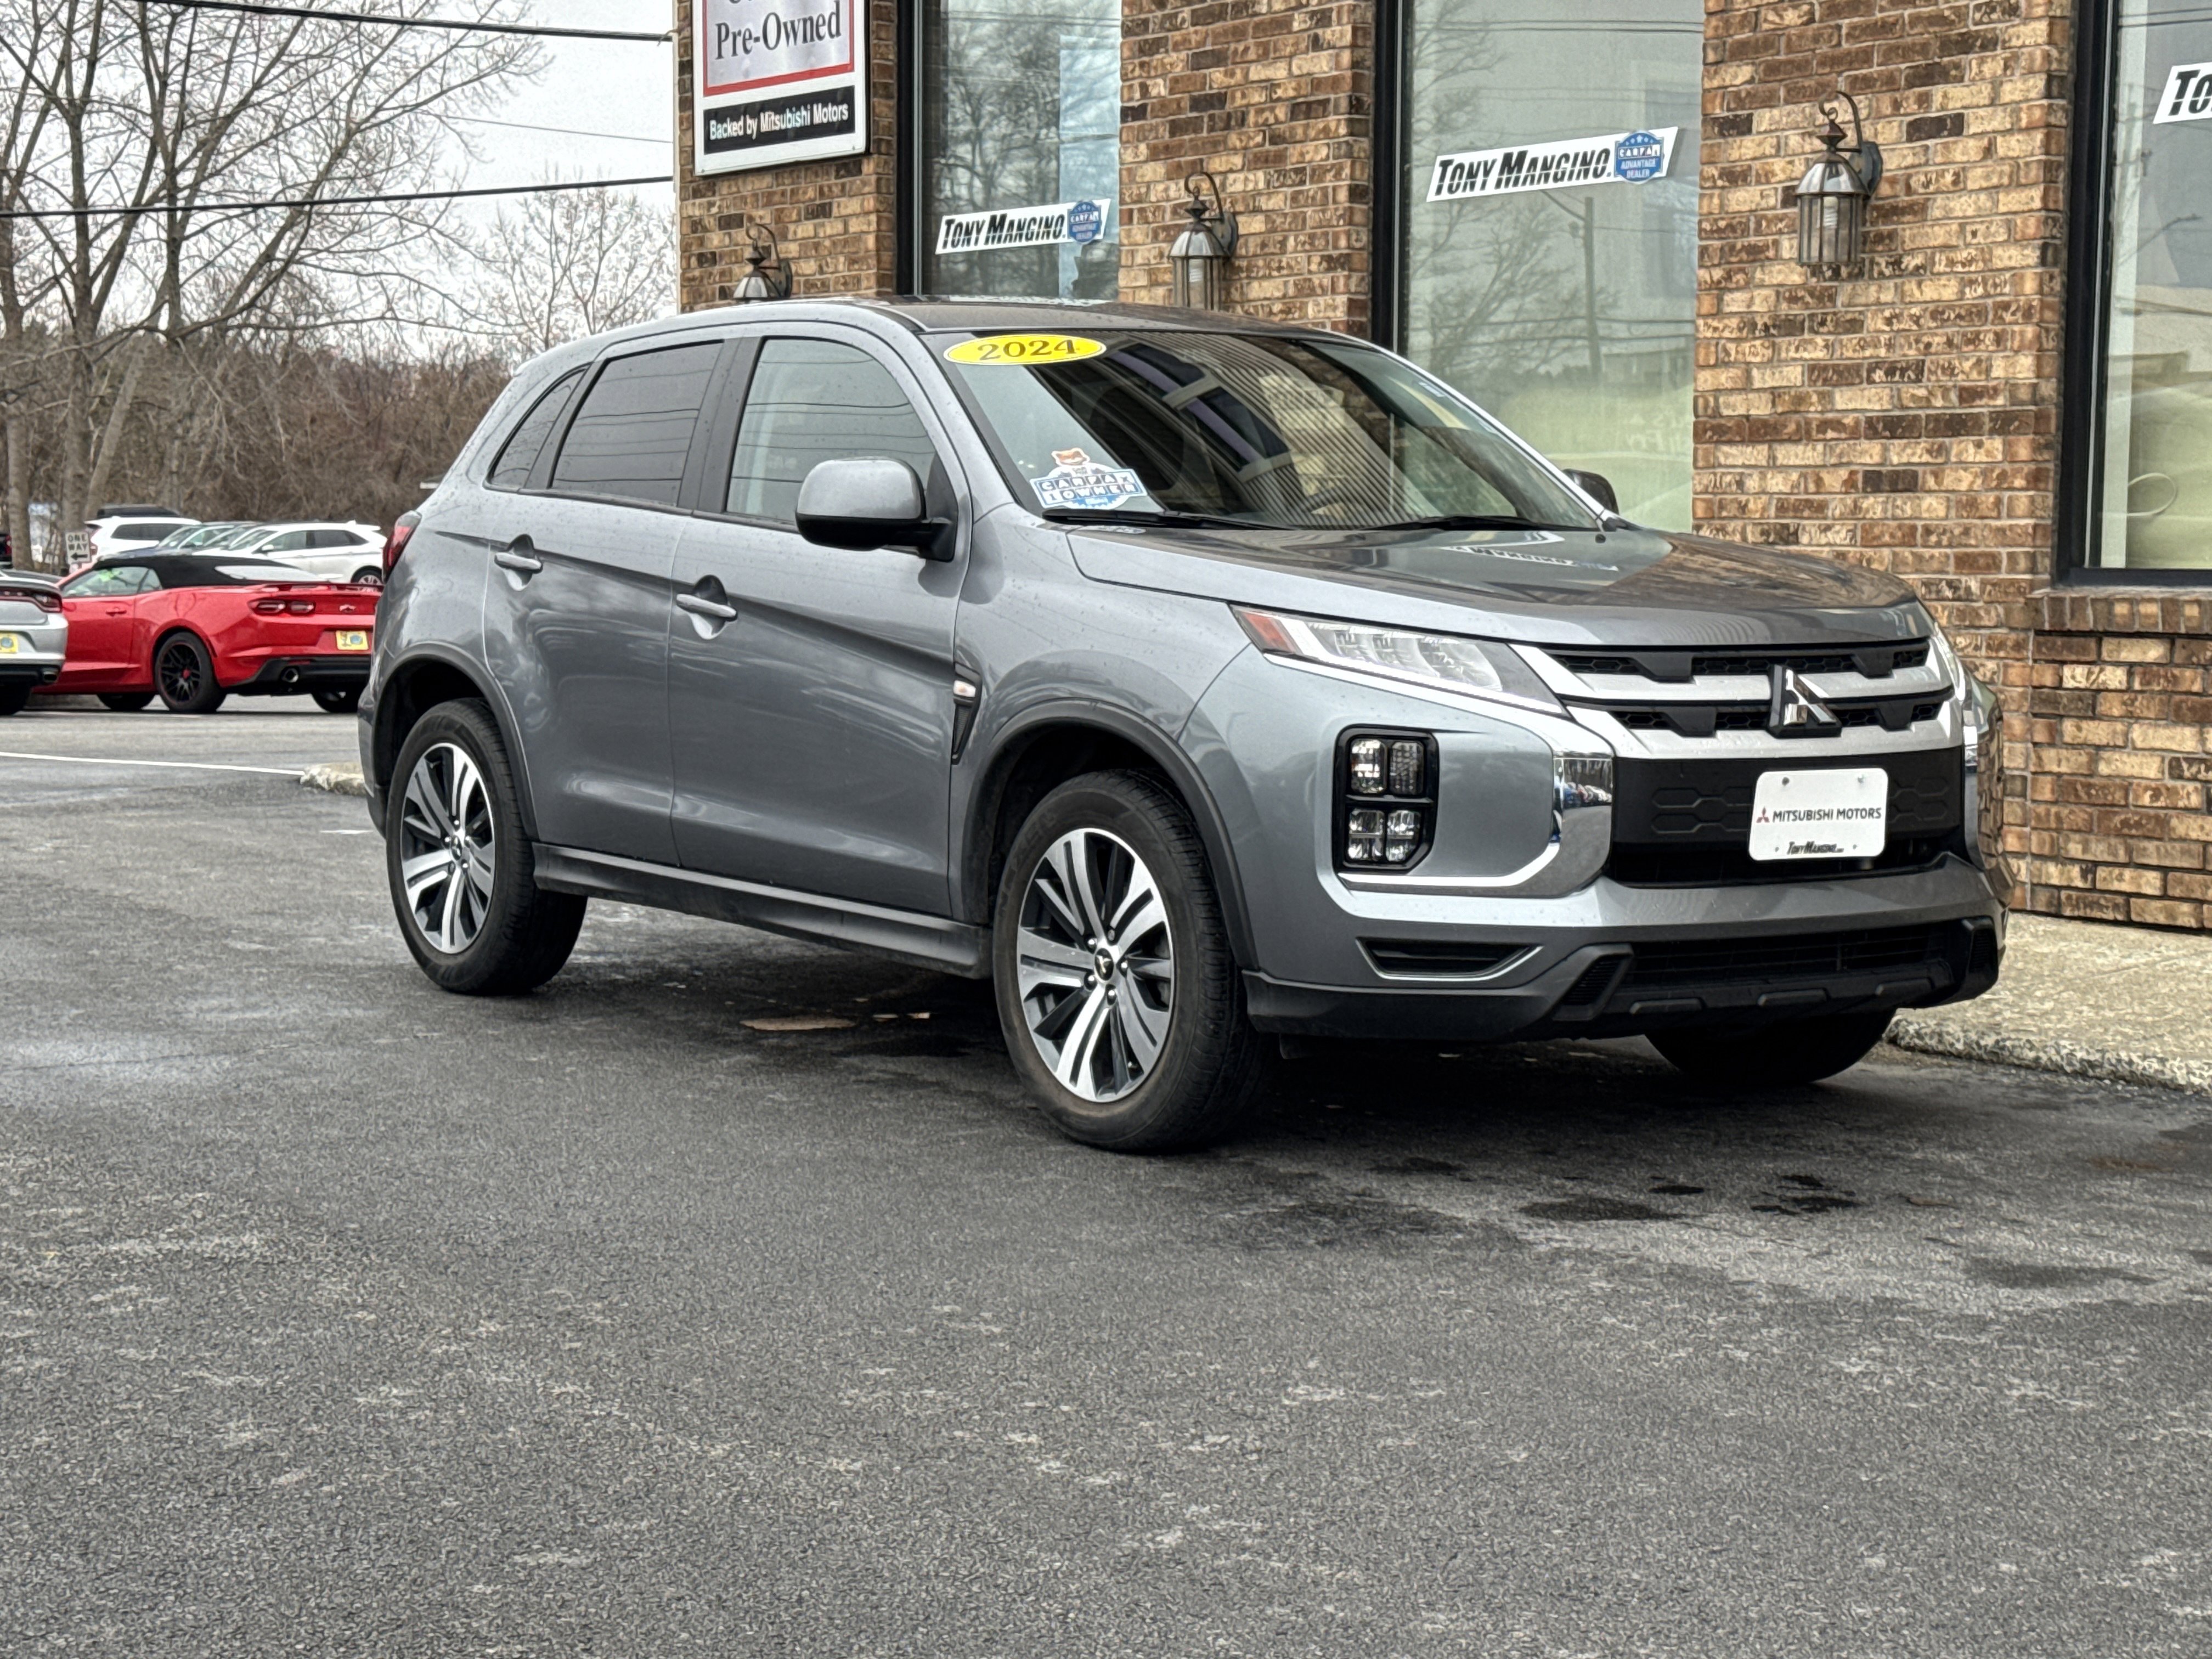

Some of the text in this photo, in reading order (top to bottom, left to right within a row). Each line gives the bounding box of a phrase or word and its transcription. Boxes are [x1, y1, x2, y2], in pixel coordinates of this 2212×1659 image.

[715, 0, 842, 60] Pre-Owned
[2168, 69, 2212, 116] TO
[709, 102, 849, 140] Backed by Mitsubishi Motors
[1620, 158, 1656, 170] ADVANTAGE
[1434, 158, 1497, 196] TONY
[941, 218, 986, 250] TONY
[977, 339, 1076, 361] 2024
[1041, 475, 1131, 490] CARFAX
[67, 534, 88, 543] ONE
[68, 543, 88, 551] WAY
[1772, 807, 1882, 823] MITSUBISHI MOTORS
